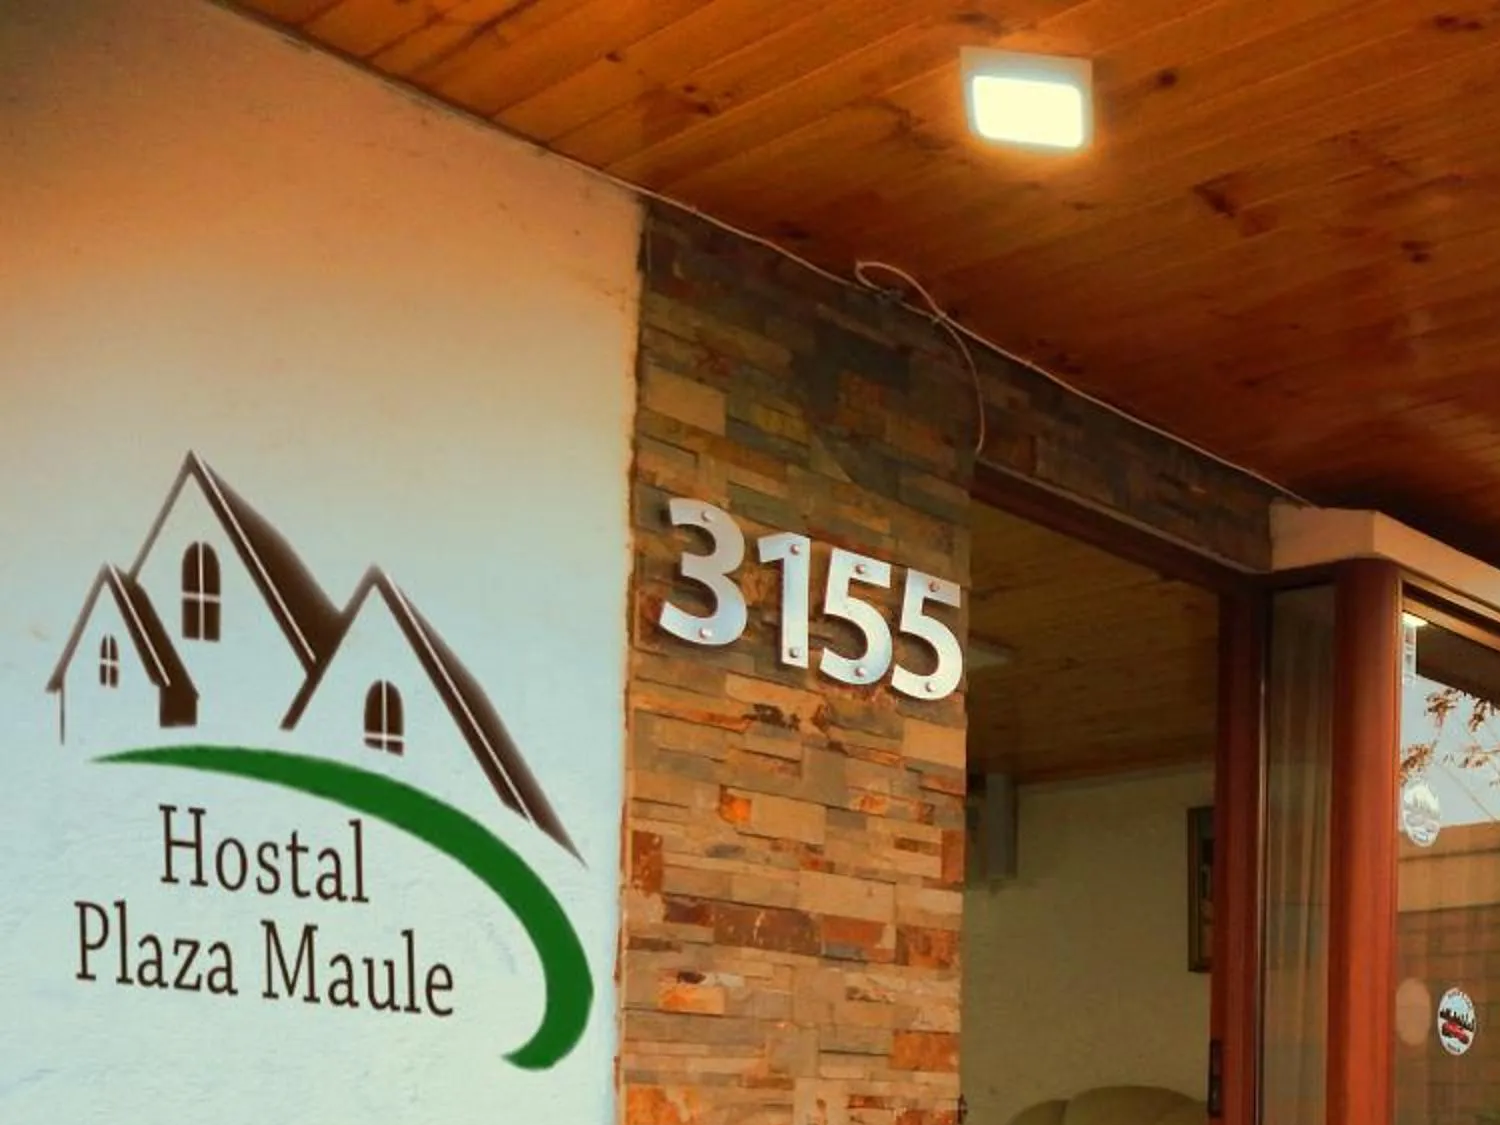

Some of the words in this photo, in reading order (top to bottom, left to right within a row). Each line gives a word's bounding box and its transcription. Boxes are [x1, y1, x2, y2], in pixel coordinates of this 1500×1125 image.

[659, 498, 963, 700] 3155
[158, 803, 370, 904] Hostal
[73, 899, 239, 997] Plaza
[259, 919, 455, 1017] Maule
